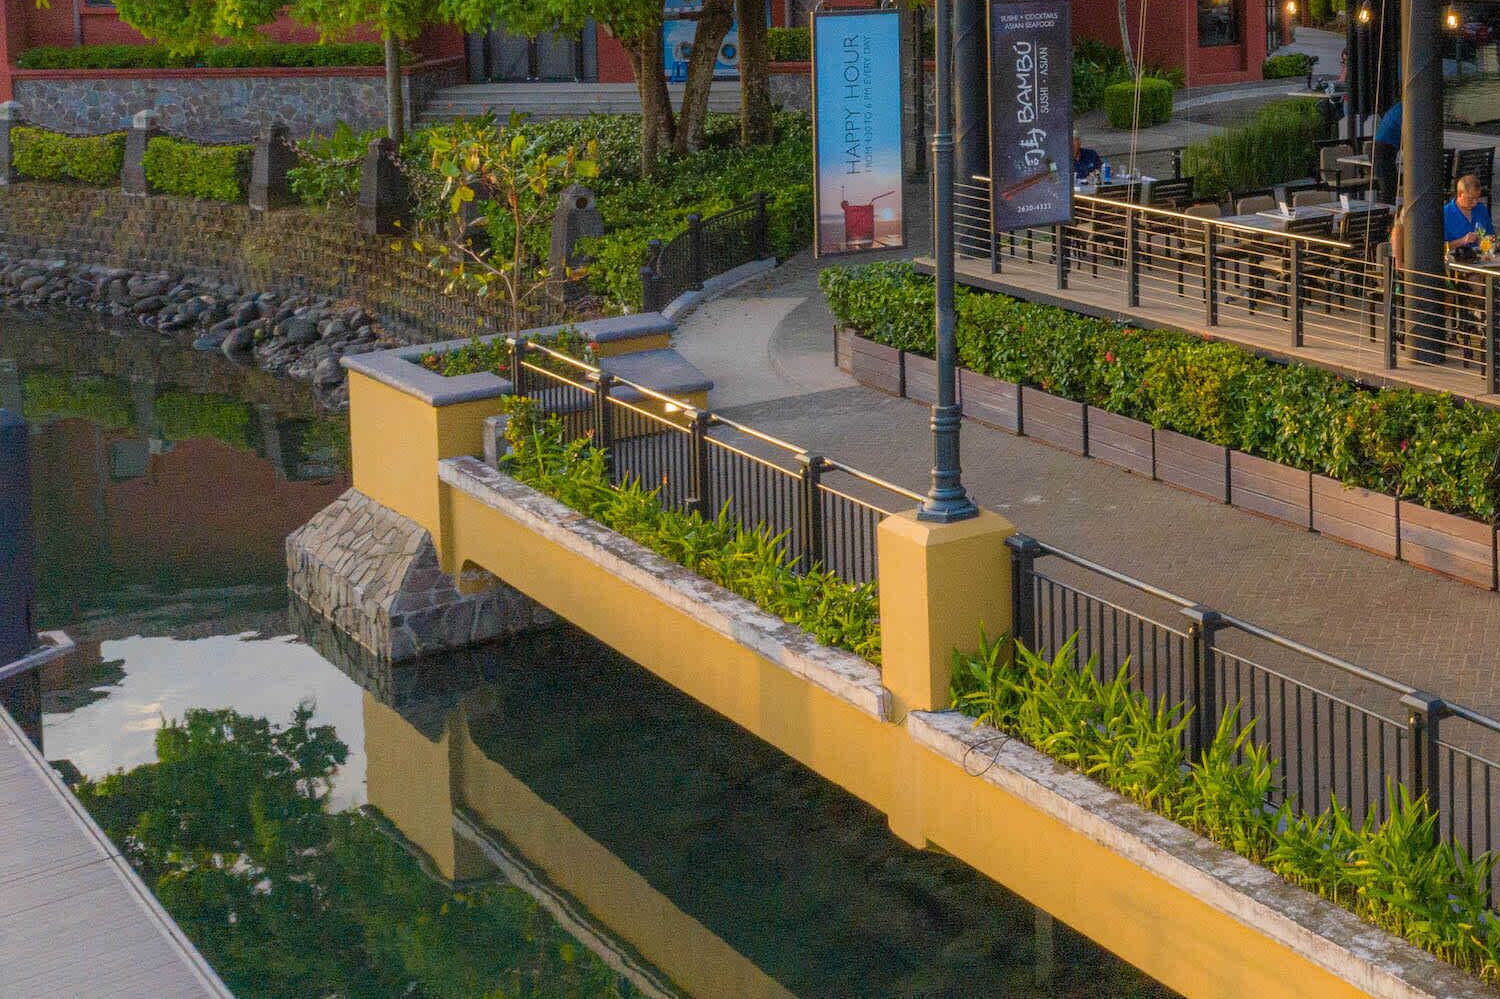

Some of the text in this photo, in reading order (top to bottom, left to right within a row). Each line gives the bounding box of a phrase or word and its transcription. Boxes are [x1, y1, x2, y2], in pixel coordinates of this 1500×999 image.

[863, 35, 873, 55] DAY
[863, 57, 873, 85] EVERY
[843, 33, 862, 175] HAPPY HOUR
[1012, 41, 1034, 123] BAMBÚ
[1039, 47, 1049, 114] SUSHI ASIAN
